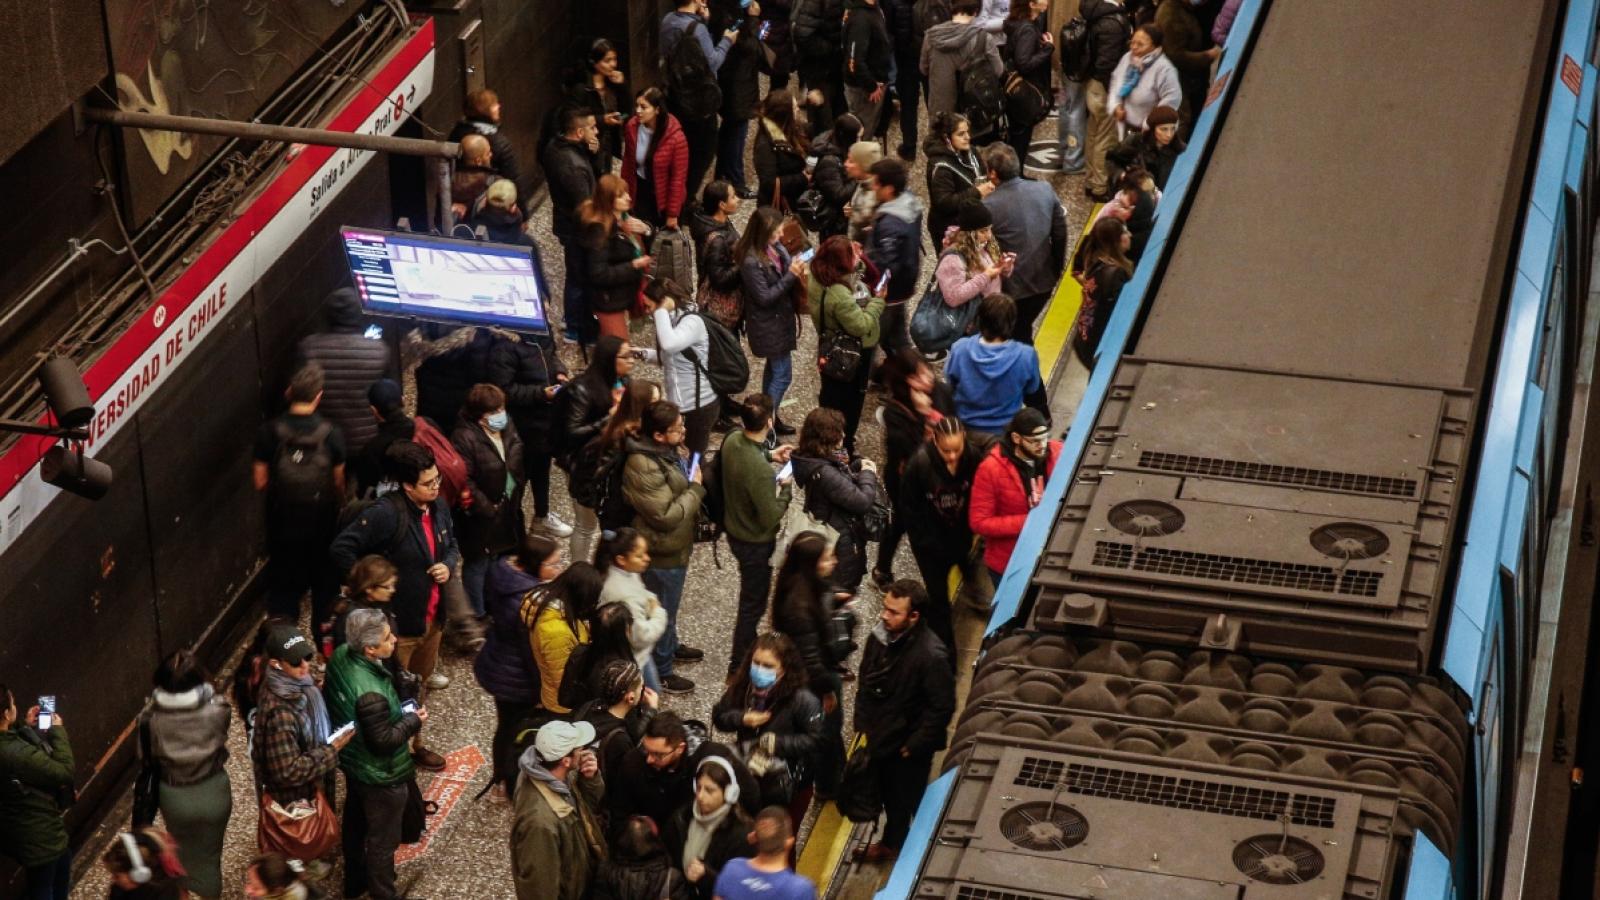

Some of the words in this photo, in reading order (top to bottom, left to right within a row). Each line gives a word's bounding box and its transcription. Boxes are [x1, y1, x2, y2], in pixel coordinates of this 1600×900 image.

[310, 167, 338, 208] Salida
[339, 160, 346, 177] a
[375, 106, 391, 136] Prat
[71, 353, 160, 456] VERSIDAD
[166, 328, 184, 366] DE
[188, 282, 228, 342] CHILE
